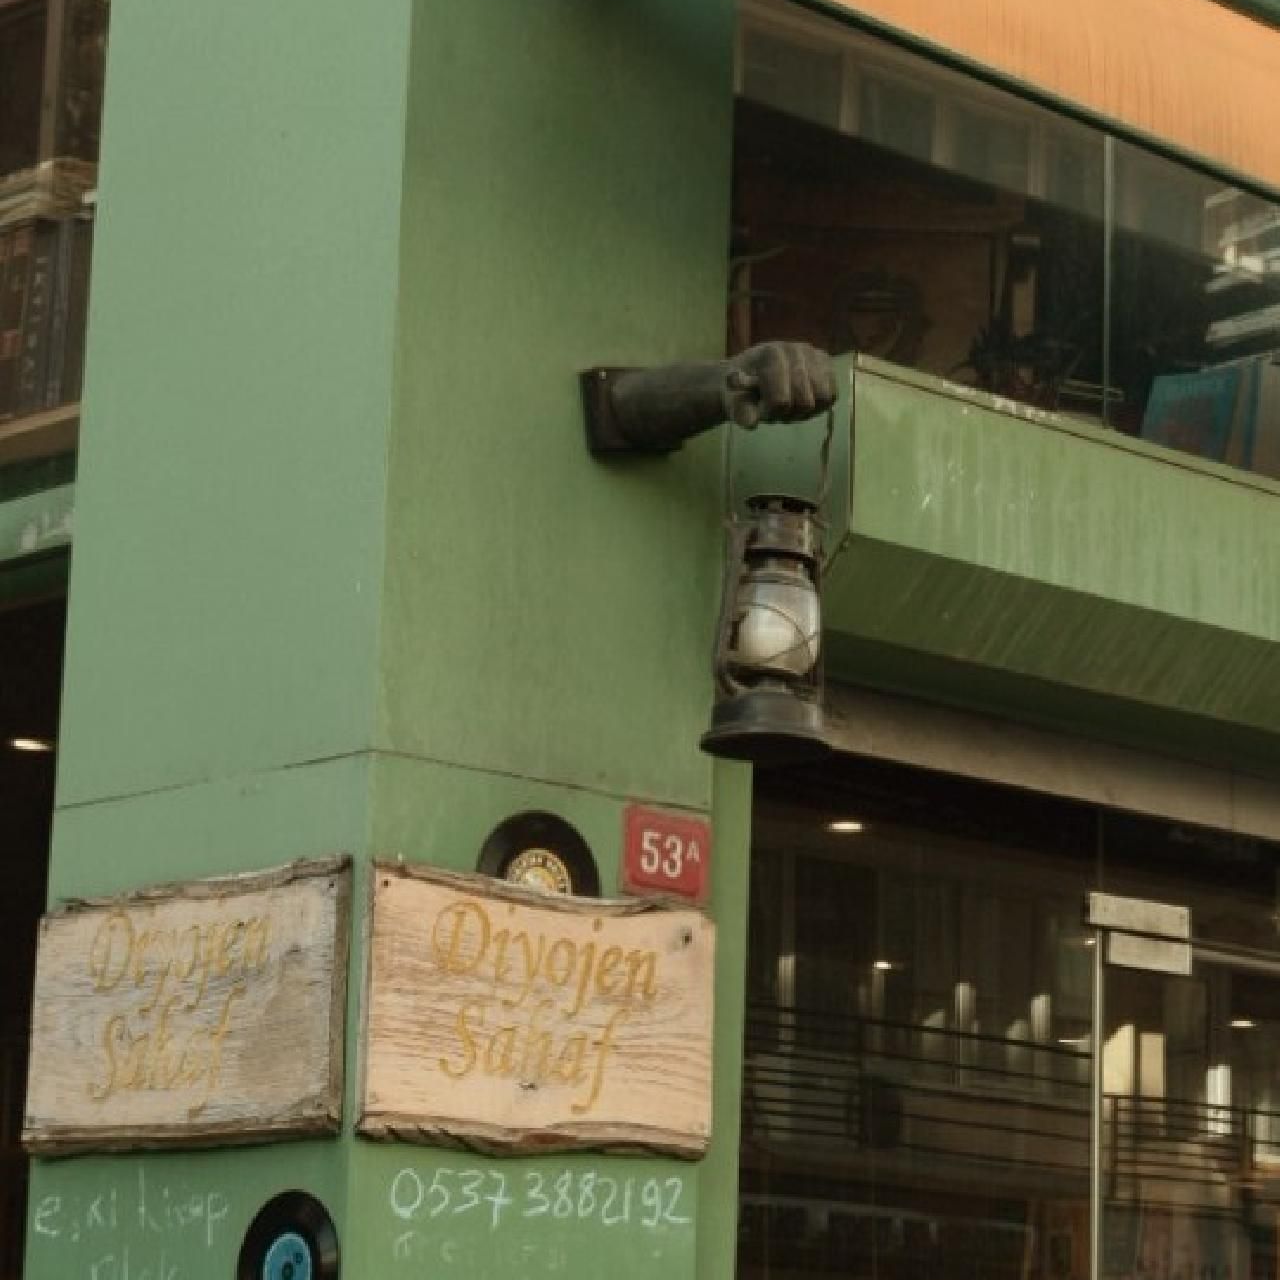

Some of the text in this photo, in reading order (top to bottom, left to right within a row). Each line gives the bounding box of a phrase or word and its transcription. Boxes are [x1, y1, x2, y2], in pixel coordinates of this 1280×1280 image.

[640, 828, 700, 879] 53A
[431, 899, 658, 1018] Diyojen
[438, 996, 629, 1115] Sahaf
